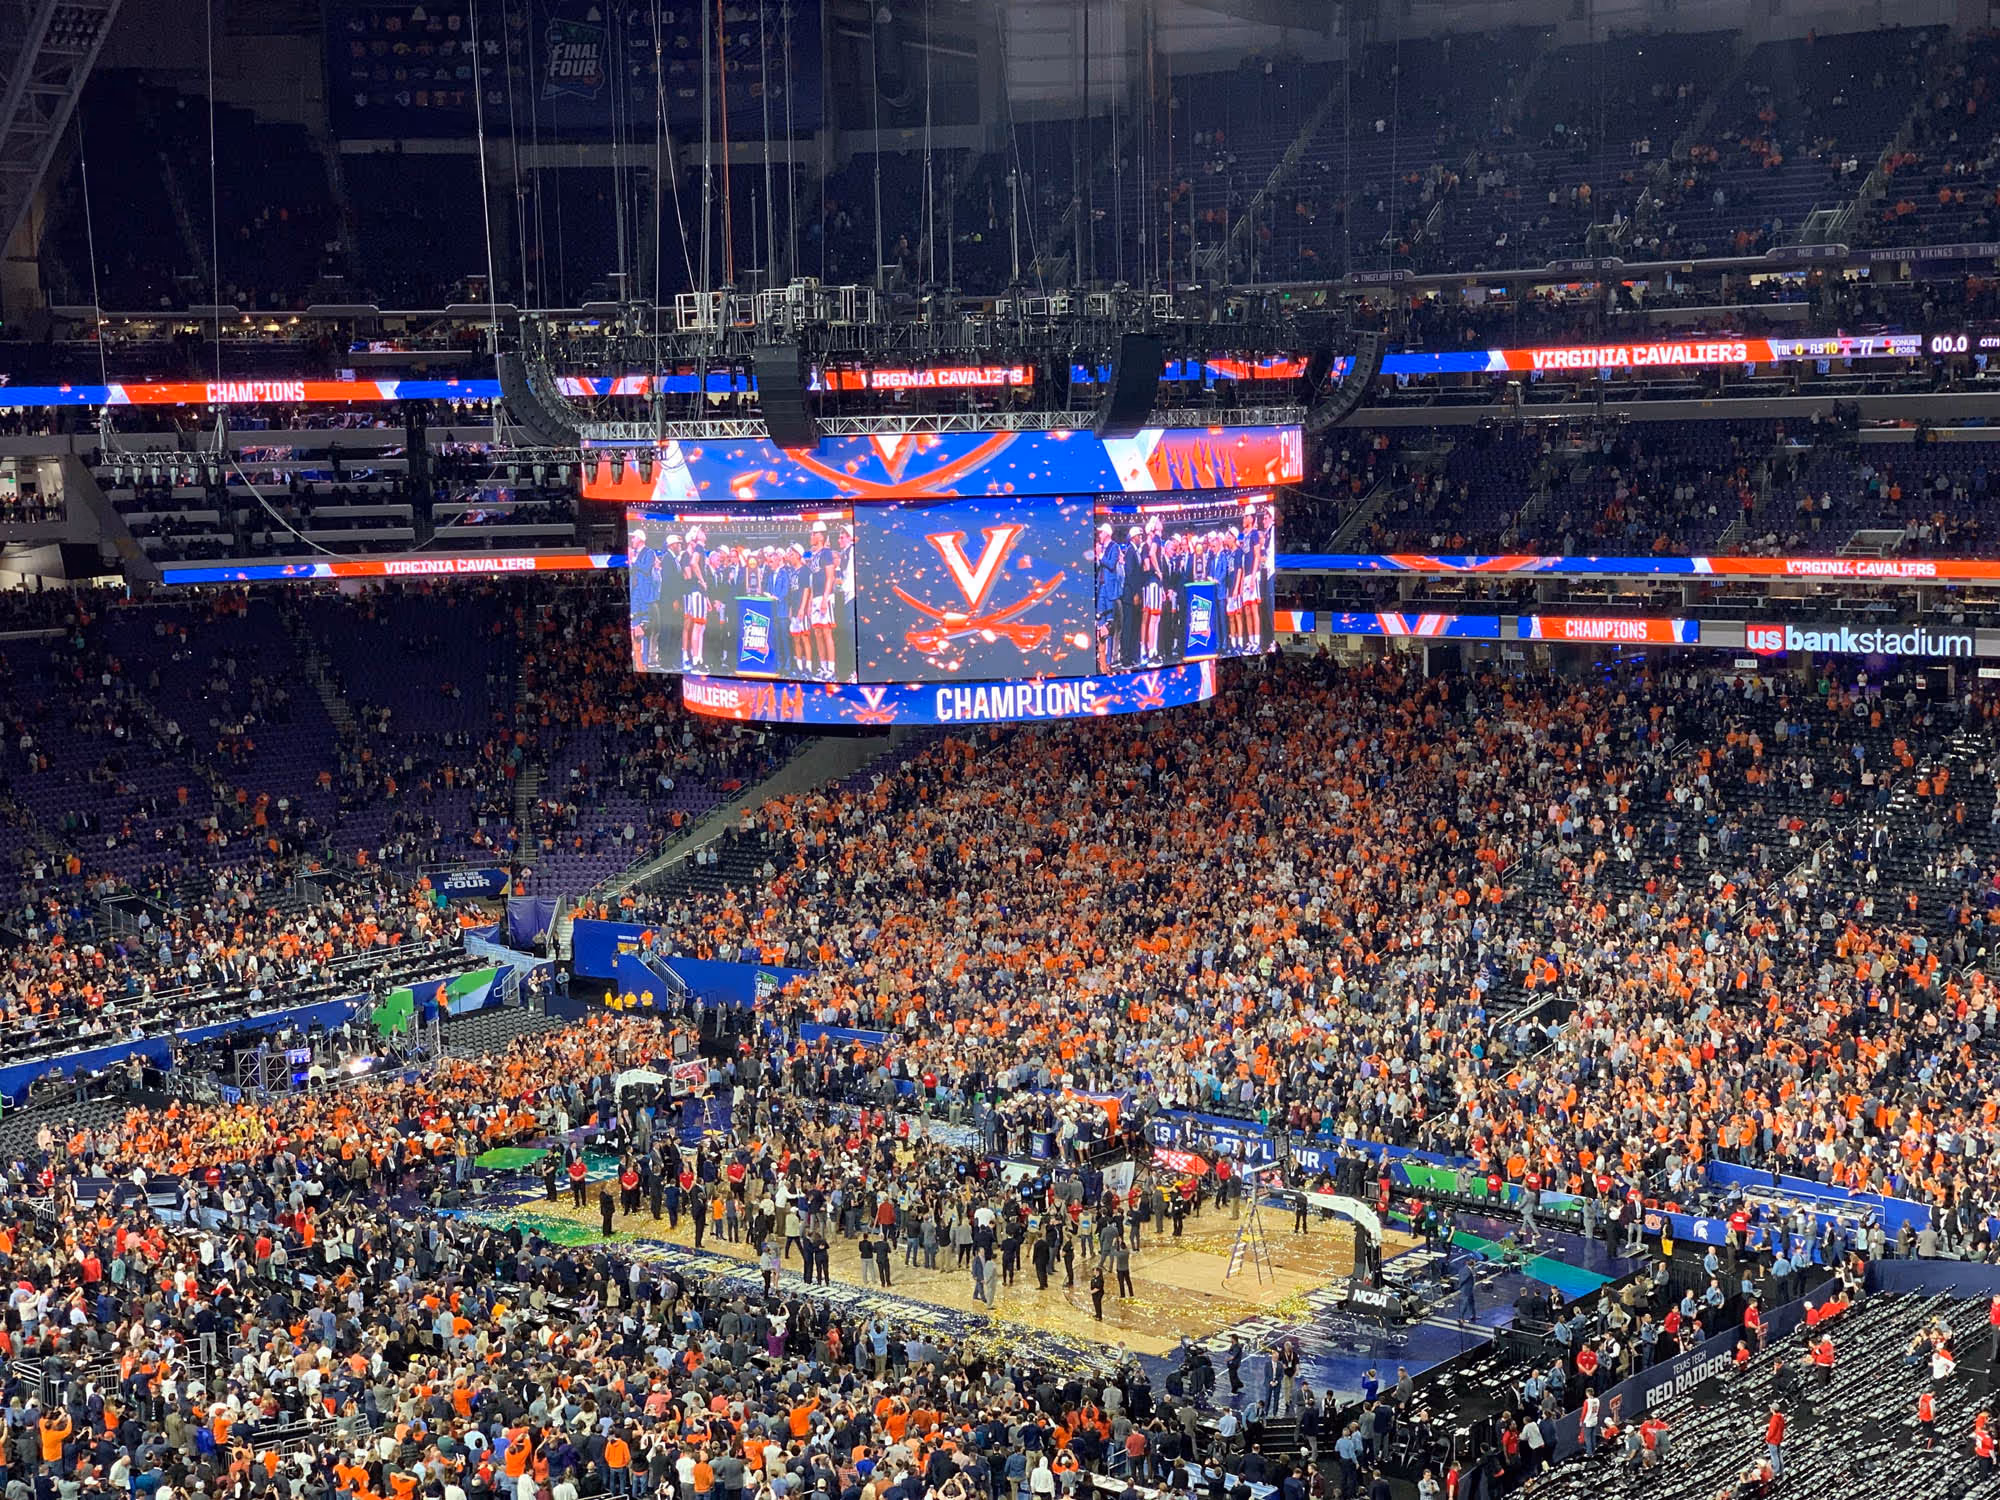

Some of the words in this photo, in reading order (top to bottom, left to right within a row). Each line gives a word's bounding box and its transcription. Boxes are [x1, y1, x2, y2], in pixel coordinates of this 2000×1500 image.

[552, 43, 599, 59] FINAL
[549, 59, 597, 77] FOUR
[1870, 249, 1915, 260] MINNESOTA
[1920, 247, 1953, 258] VIKINGS
[1777, 345, 1791, 355] TOL
[1795, 344, 1804, 355] 0
[1810, 343, 1824, 354] FLS
[1824, 342, 1838, 354] 10
[1860, 339, 1874, 355] 77
[1932, 336, 1967, 353] 00.0
[1532, 348, 1631, 369] VIRGINIA
[1632, 343, 1747, 364] CAVALIERS
[206, 382, 305, 403] CHAMPIONS
[384, 559, 455, 574] VIRGINIA
[457, 557, 536, 572] CAVALIERS
[1786, 560, 1854, 574] VIRGINIA
[1856, 561, 1937, 576] CAVALIERS
[1565, 619, 1647, 639] CHAMPIONS
[936, 680, 1096, 720] CHAMPIONS
[443, 879, 491, 889] FOUR
[1352, 1288, 1388, 1308] NCAA
[1672, 1357, 1691, 1375] TEXAS
[1691, 1350, 1707, 1365] TECH
[1646, 1380, 1673, 1409] RED
[1675, 1350, 1732, 1395] RAIDERS
